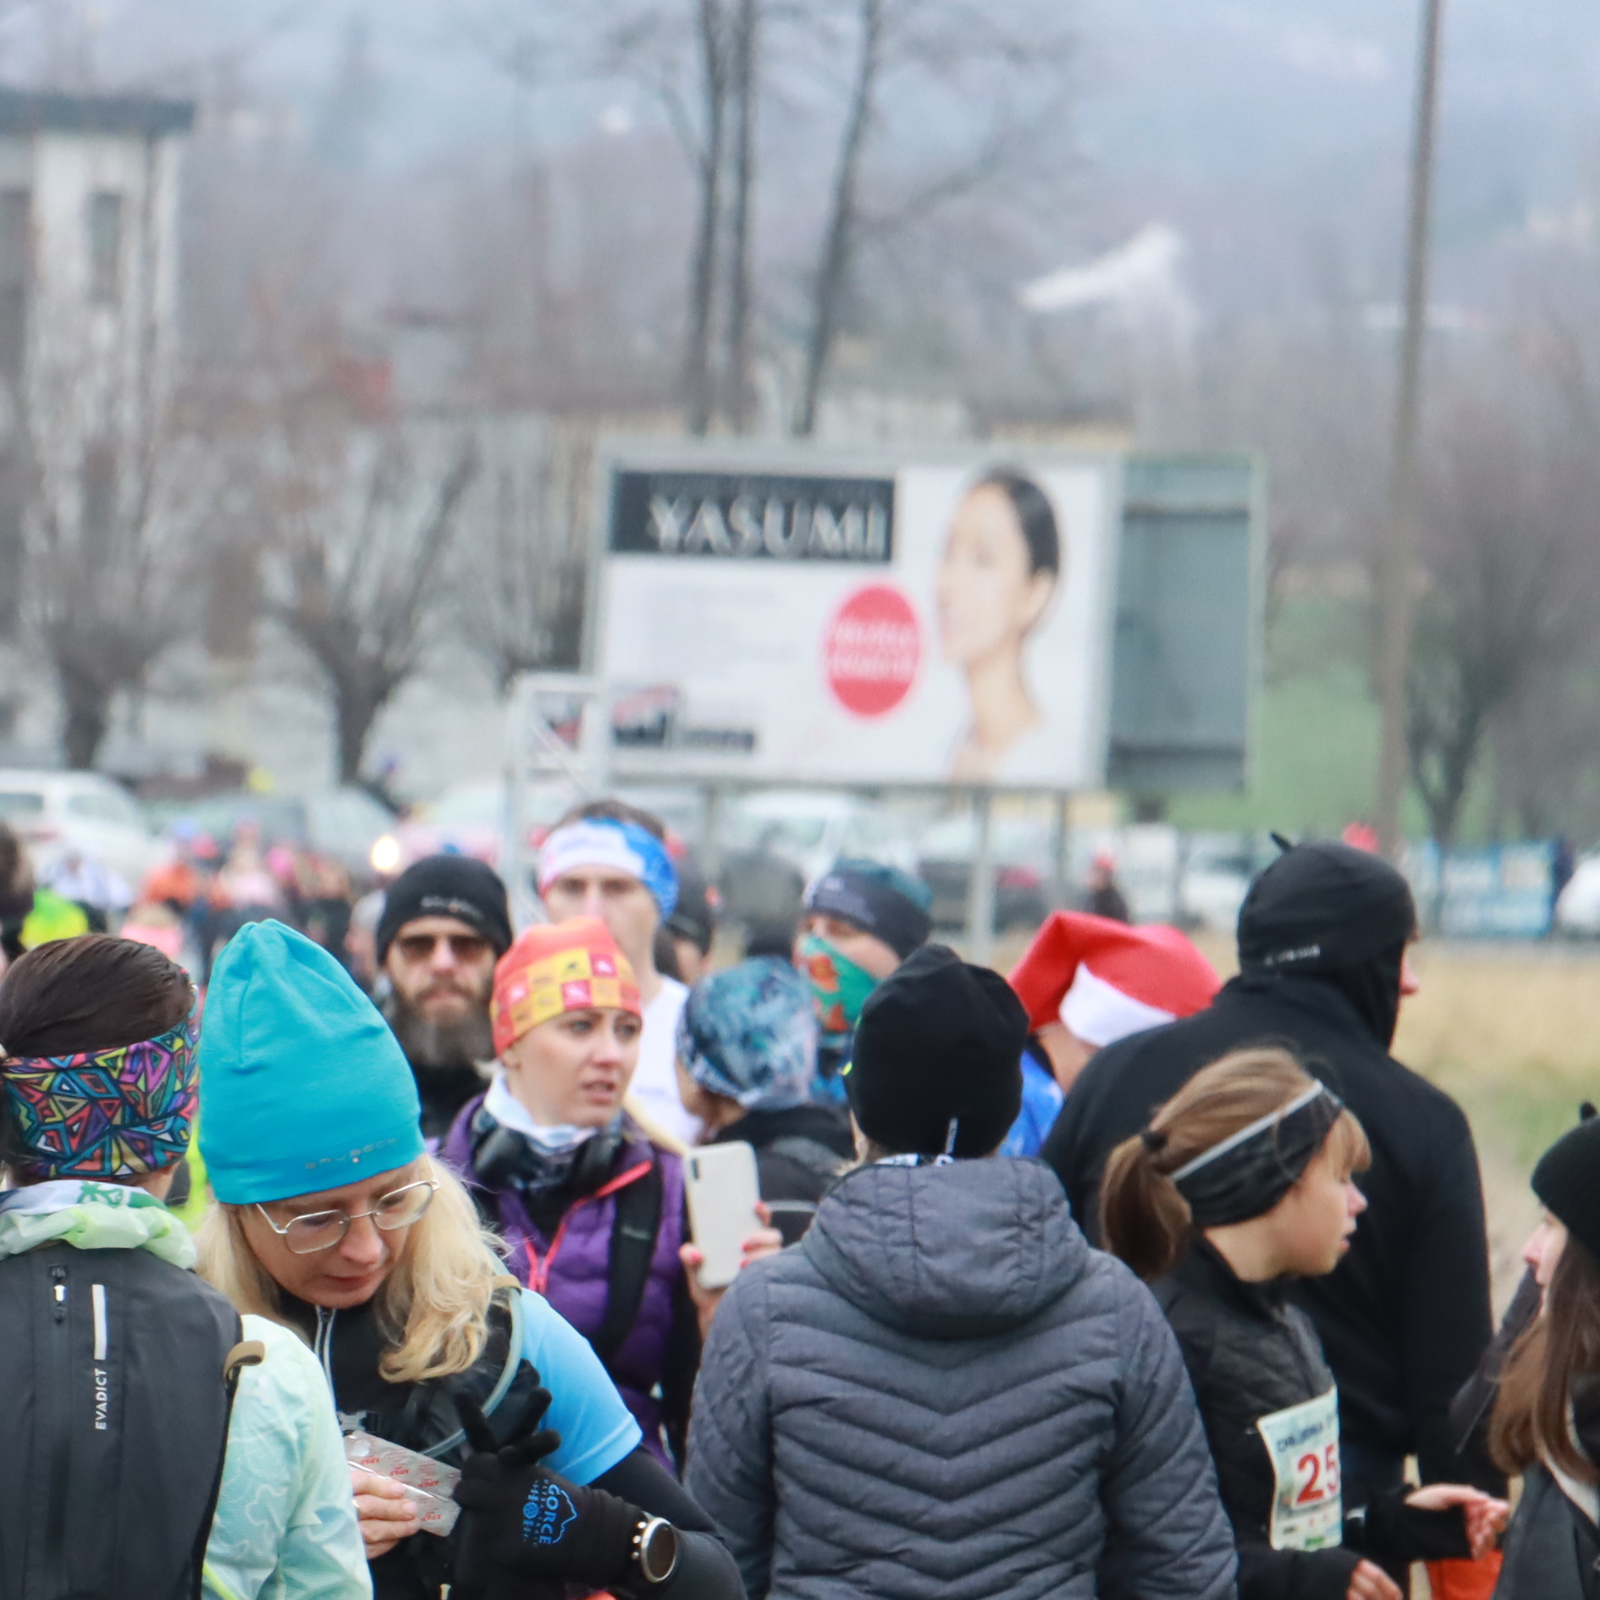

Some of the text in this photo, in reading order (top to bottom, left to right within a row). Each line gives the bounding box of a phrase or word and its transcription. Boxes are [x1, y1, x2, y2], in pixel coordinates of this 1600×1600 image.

[648, 494, 888, 561] YASUMI
[94, 1368, 107, 1430] EVADICT
[539, 1484, 560, 1544] GORCE
